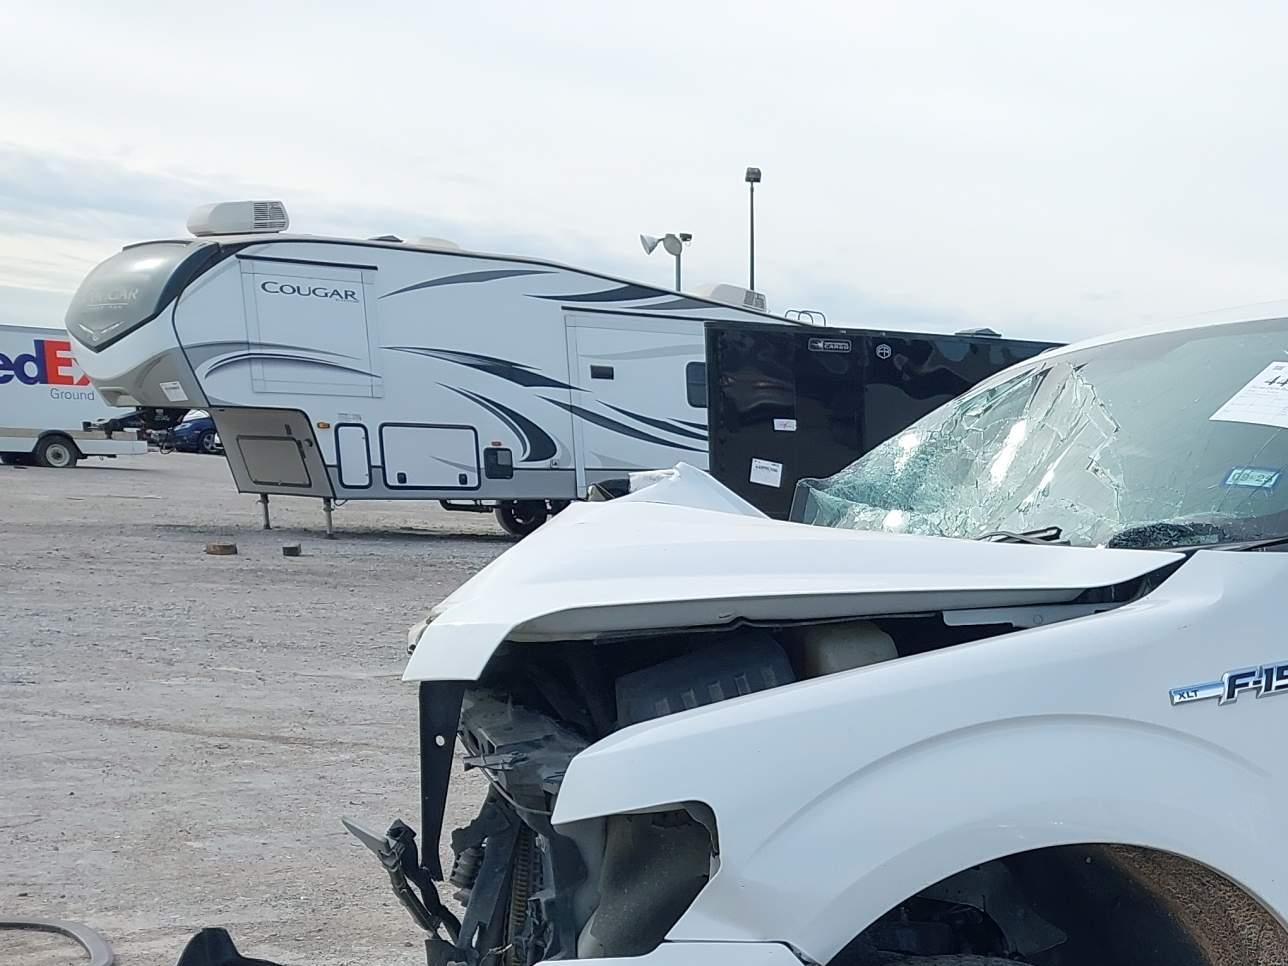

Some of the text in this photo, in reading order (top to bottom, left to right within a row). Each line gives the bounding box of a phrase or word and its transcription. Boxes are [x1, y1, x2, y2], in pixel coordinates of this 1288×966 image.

[261, 281, 360, 301] COUGAR
[50, 388, 95, 401] Ground
[1177, 689, 1199, 701] XLT
